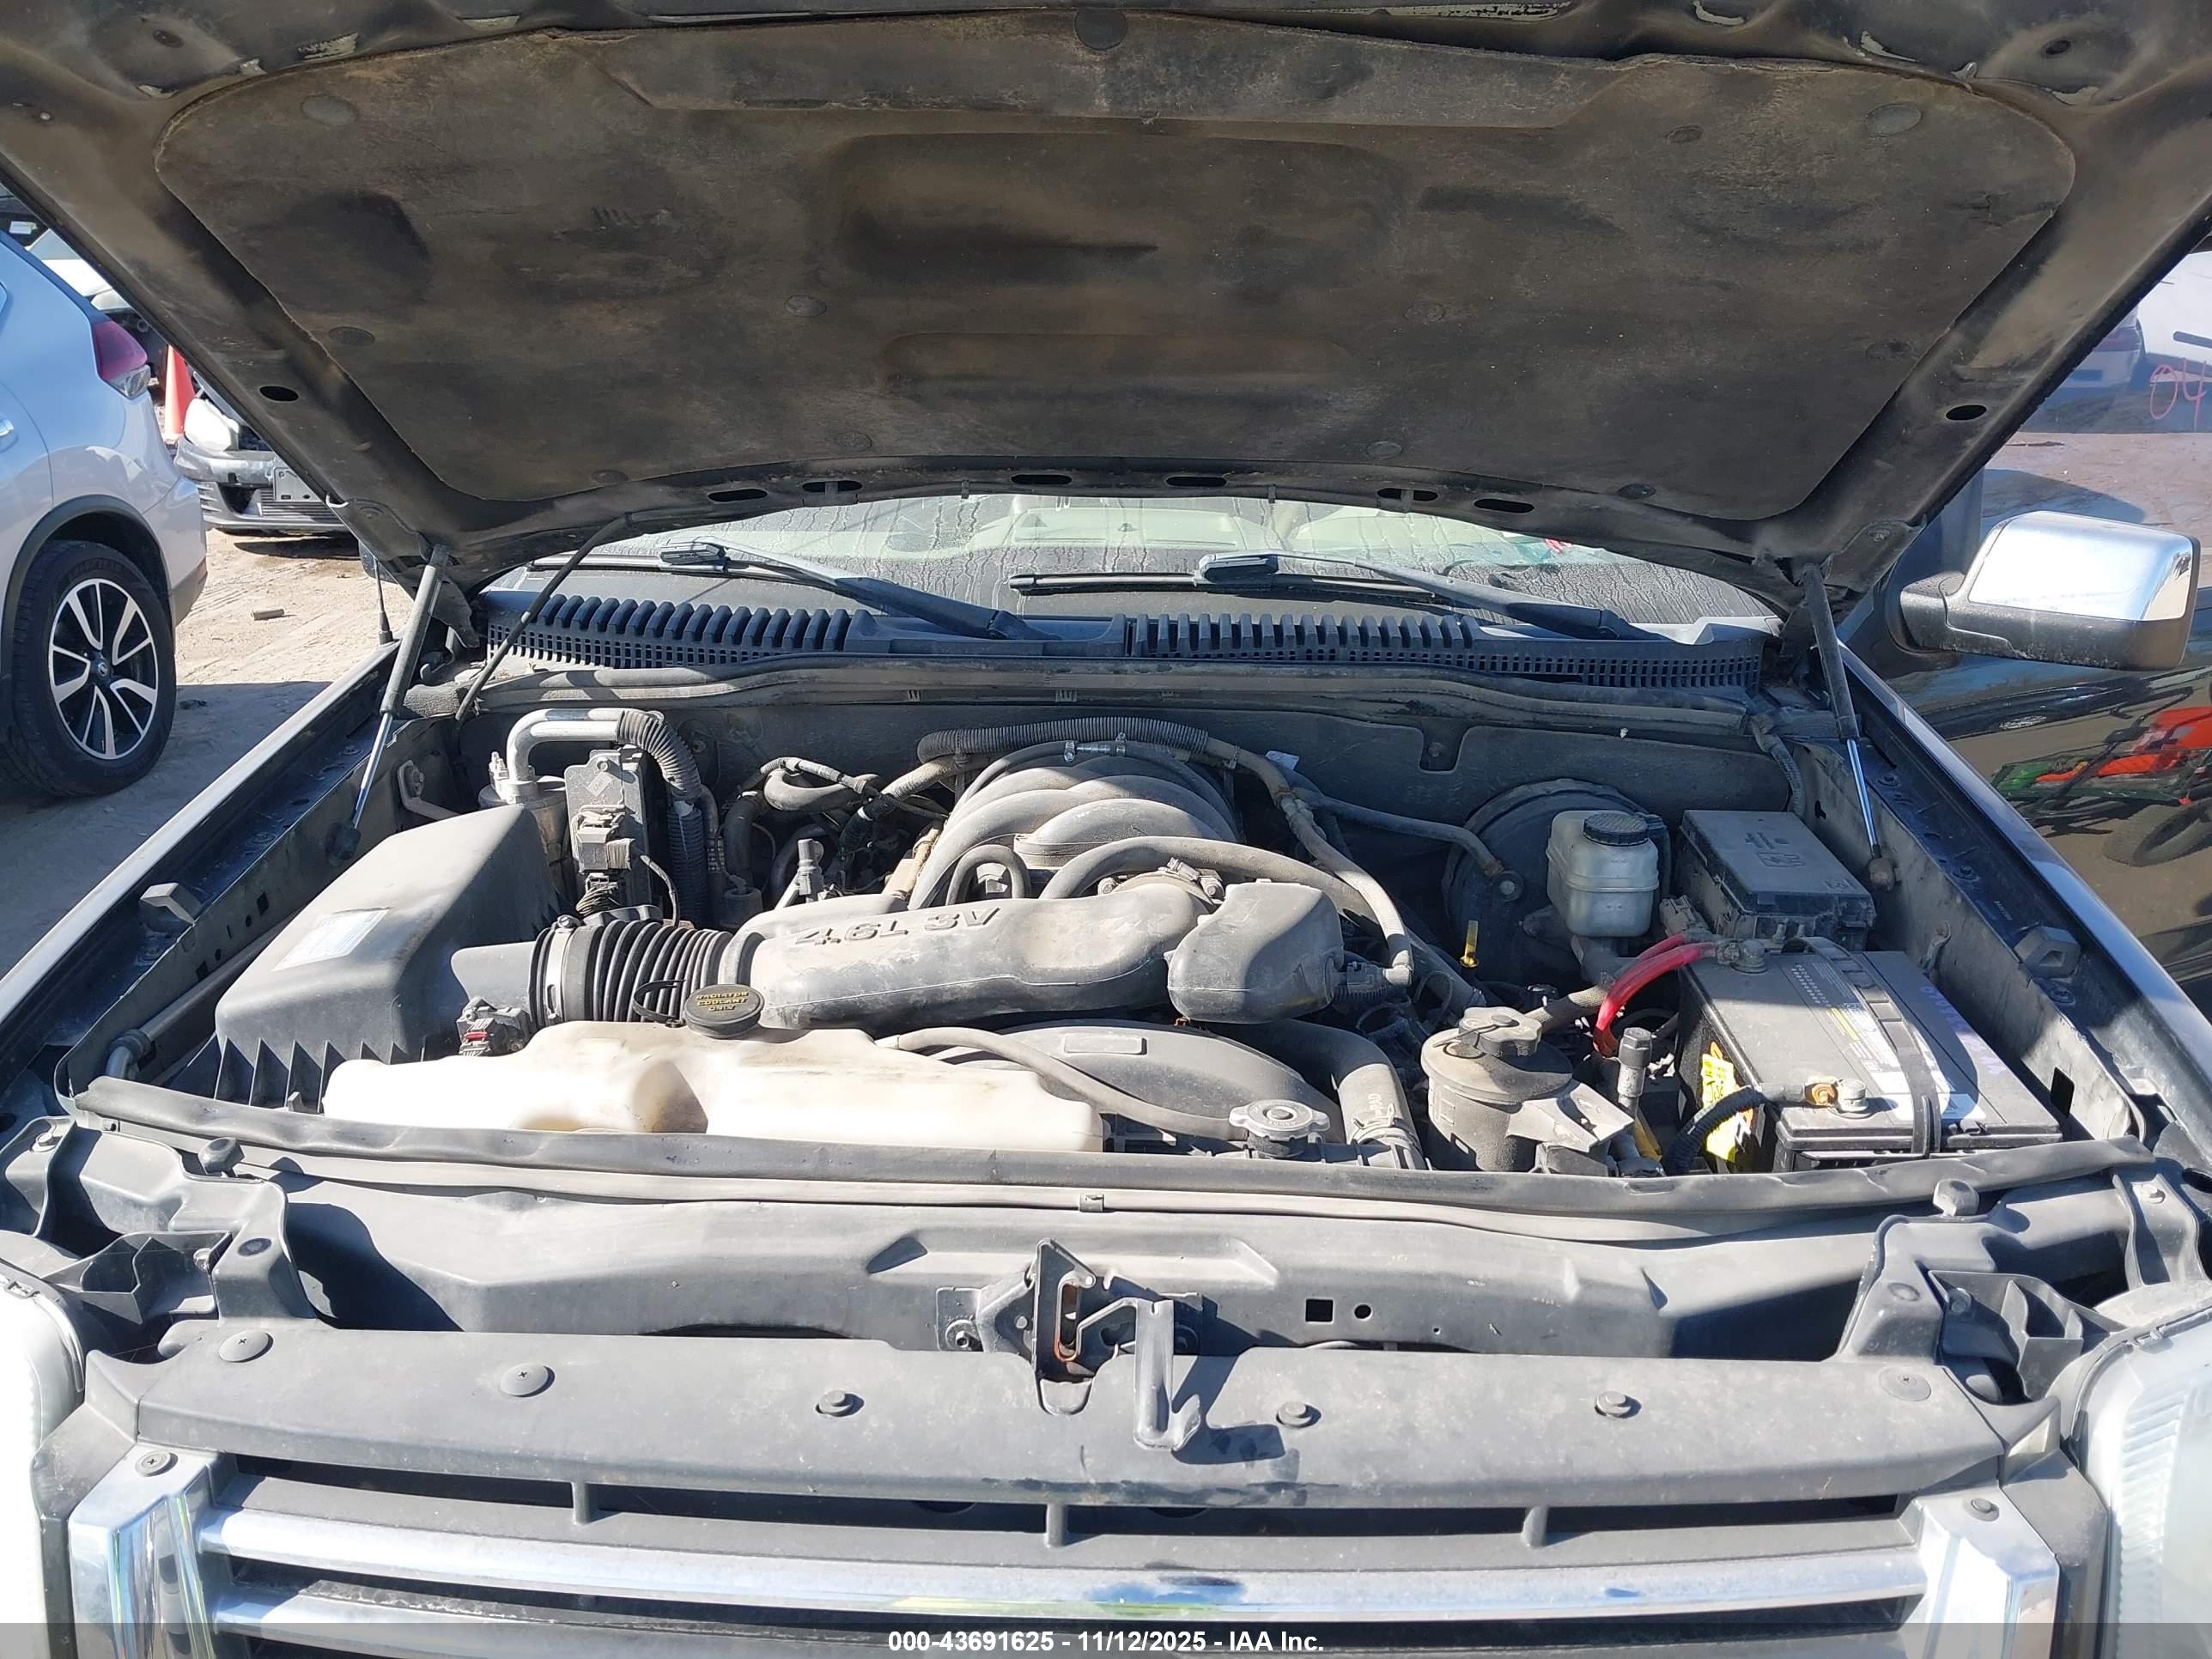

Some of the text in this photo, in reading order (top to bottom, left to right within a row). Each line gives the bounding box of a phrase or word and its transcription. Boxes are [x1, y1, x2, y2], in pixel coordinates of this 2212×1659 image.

[795, 907, 1001, 945] 4.6L 3V
[697, 997, 749, 1007] COOLANT
[708, 1004, 737, 1012] ONLY
